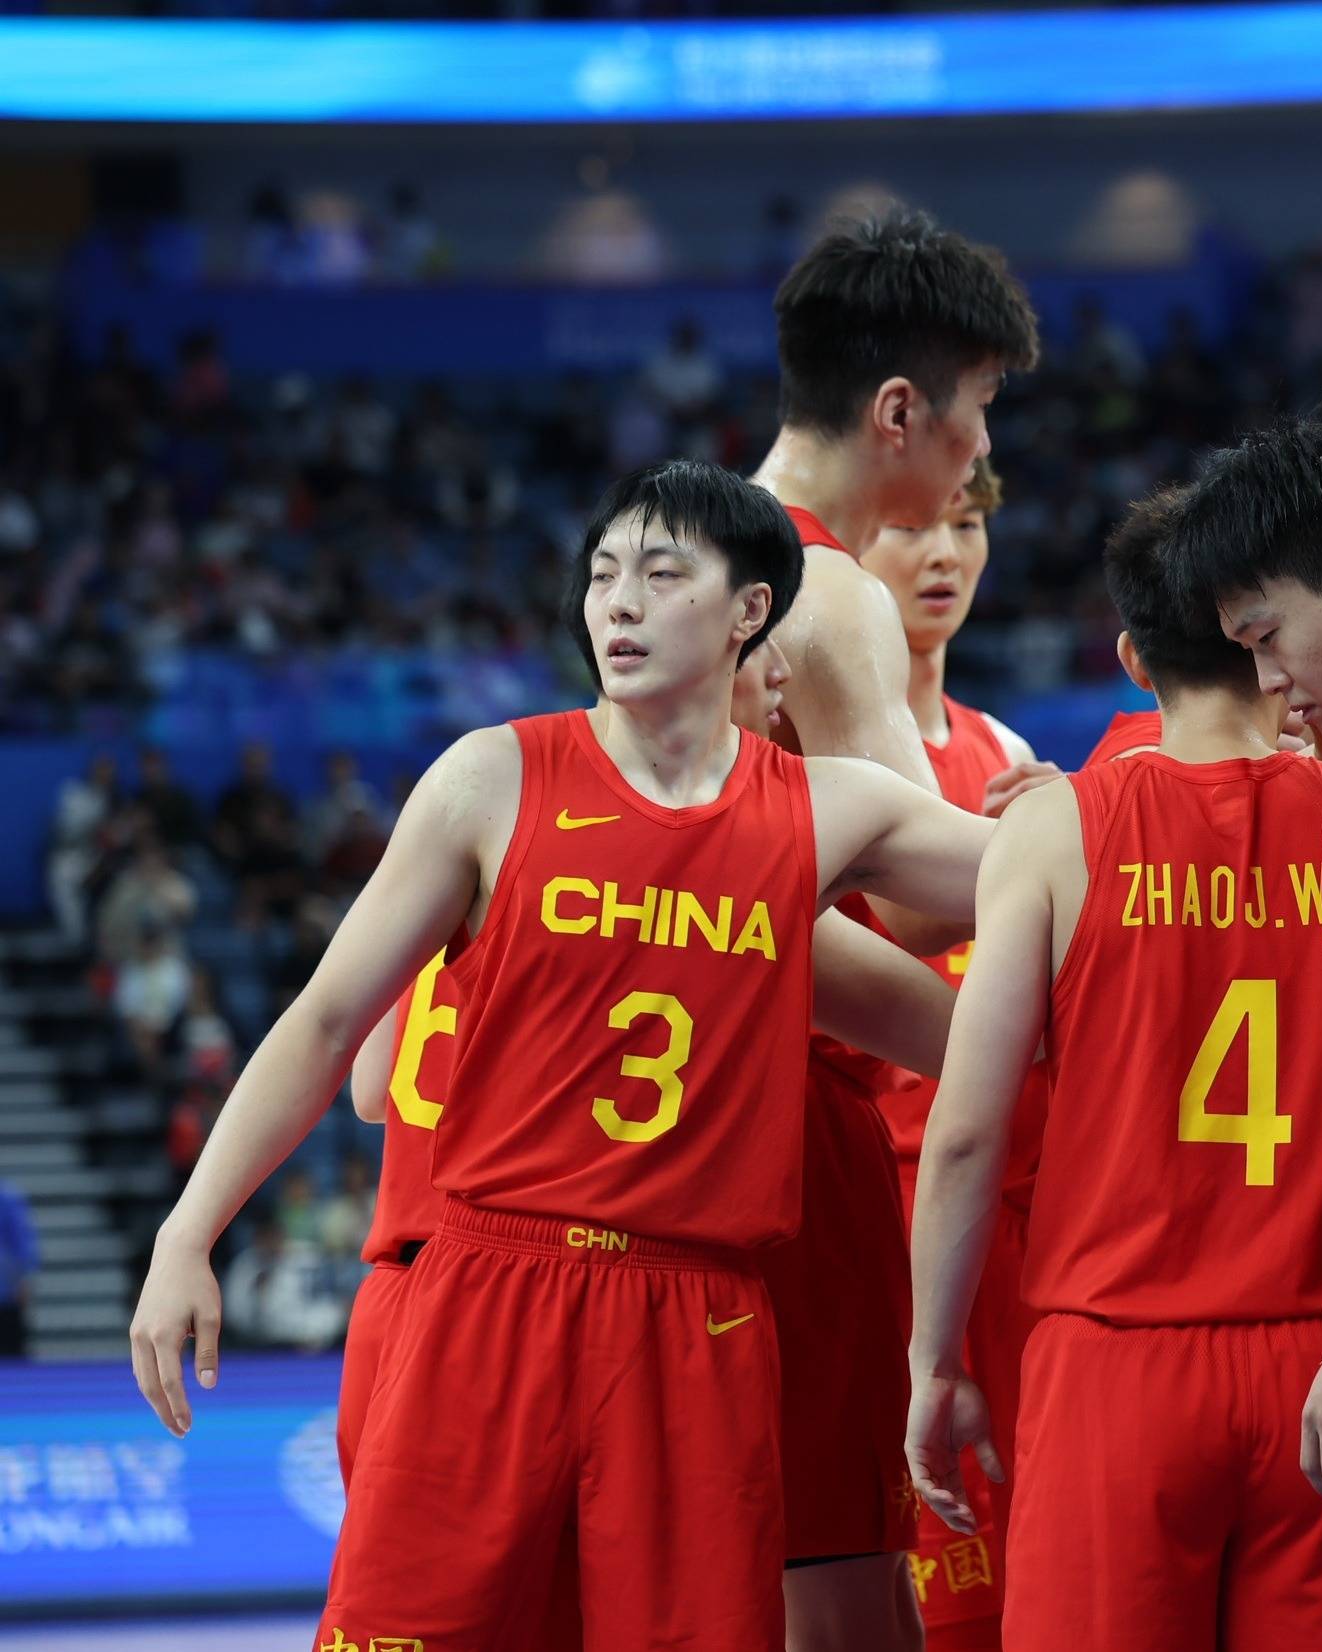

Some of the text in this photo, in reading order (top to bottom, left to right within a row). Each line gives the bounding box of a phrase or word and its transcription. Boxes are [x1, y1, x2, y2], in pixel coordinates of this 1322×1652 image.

[540, 876, 777, 961] CHINA
[592, 991, 694, 1143] 3
[1178, 979, 1291, 1186] 4
[566, 1227, 628, 1252] CHN
